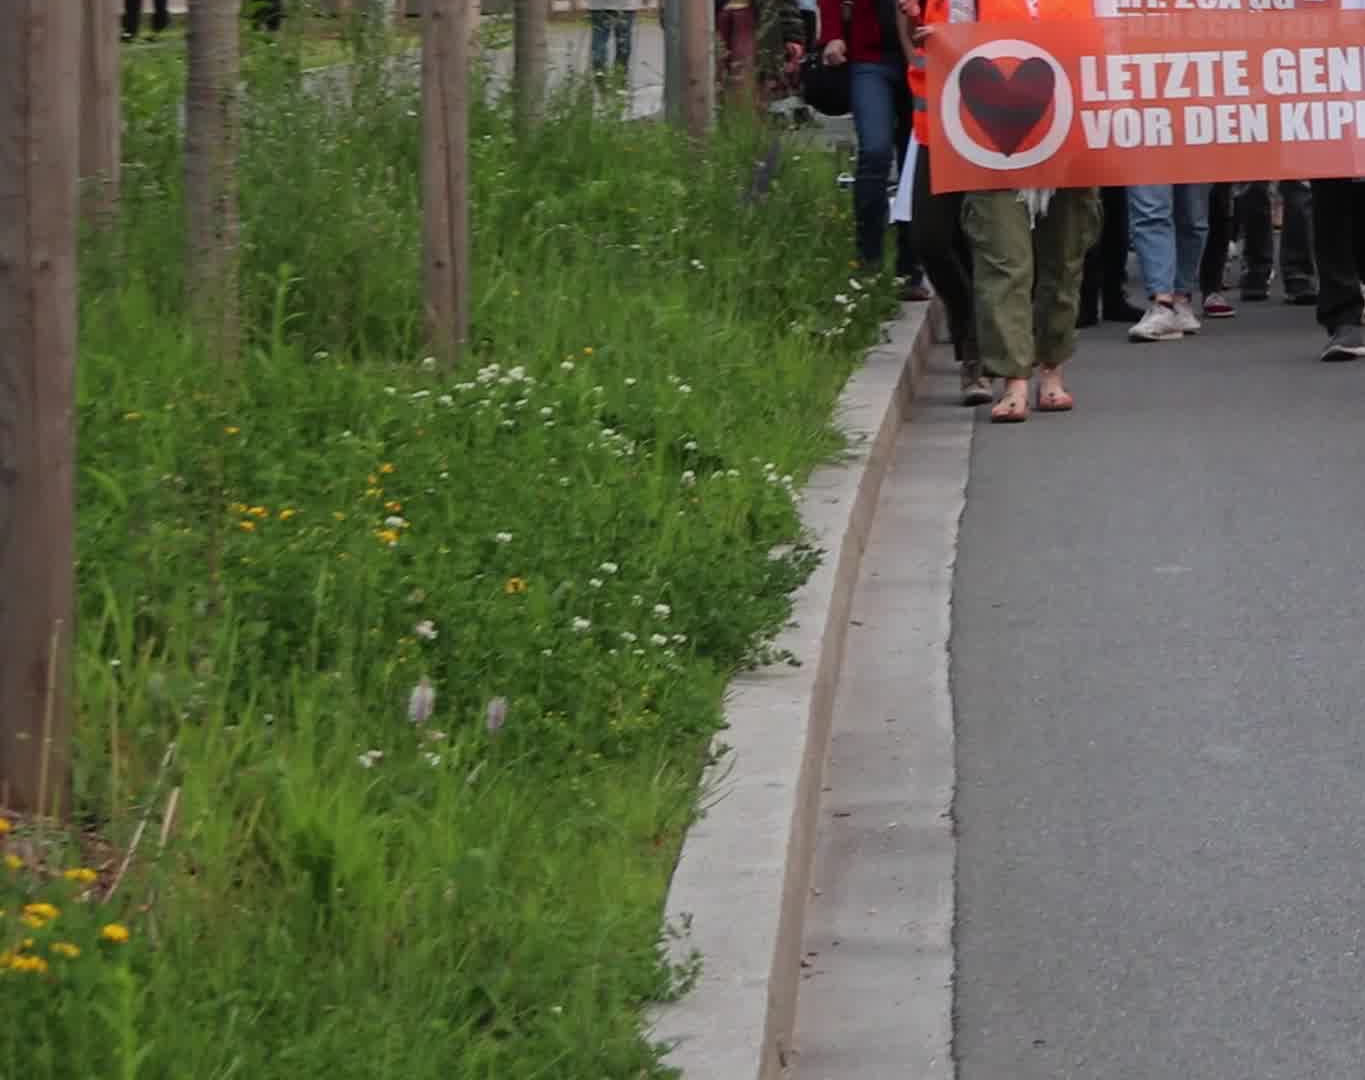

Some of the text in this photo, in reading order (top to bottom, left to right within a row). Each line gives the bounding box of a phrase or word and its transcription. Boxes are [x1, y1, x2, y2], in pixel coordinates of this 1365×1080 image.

[1080, 50, 1249, 102] LETZTE
[1080, 107, 1173, 149] VOR
[1184, 102, 1269, 145] DEN
